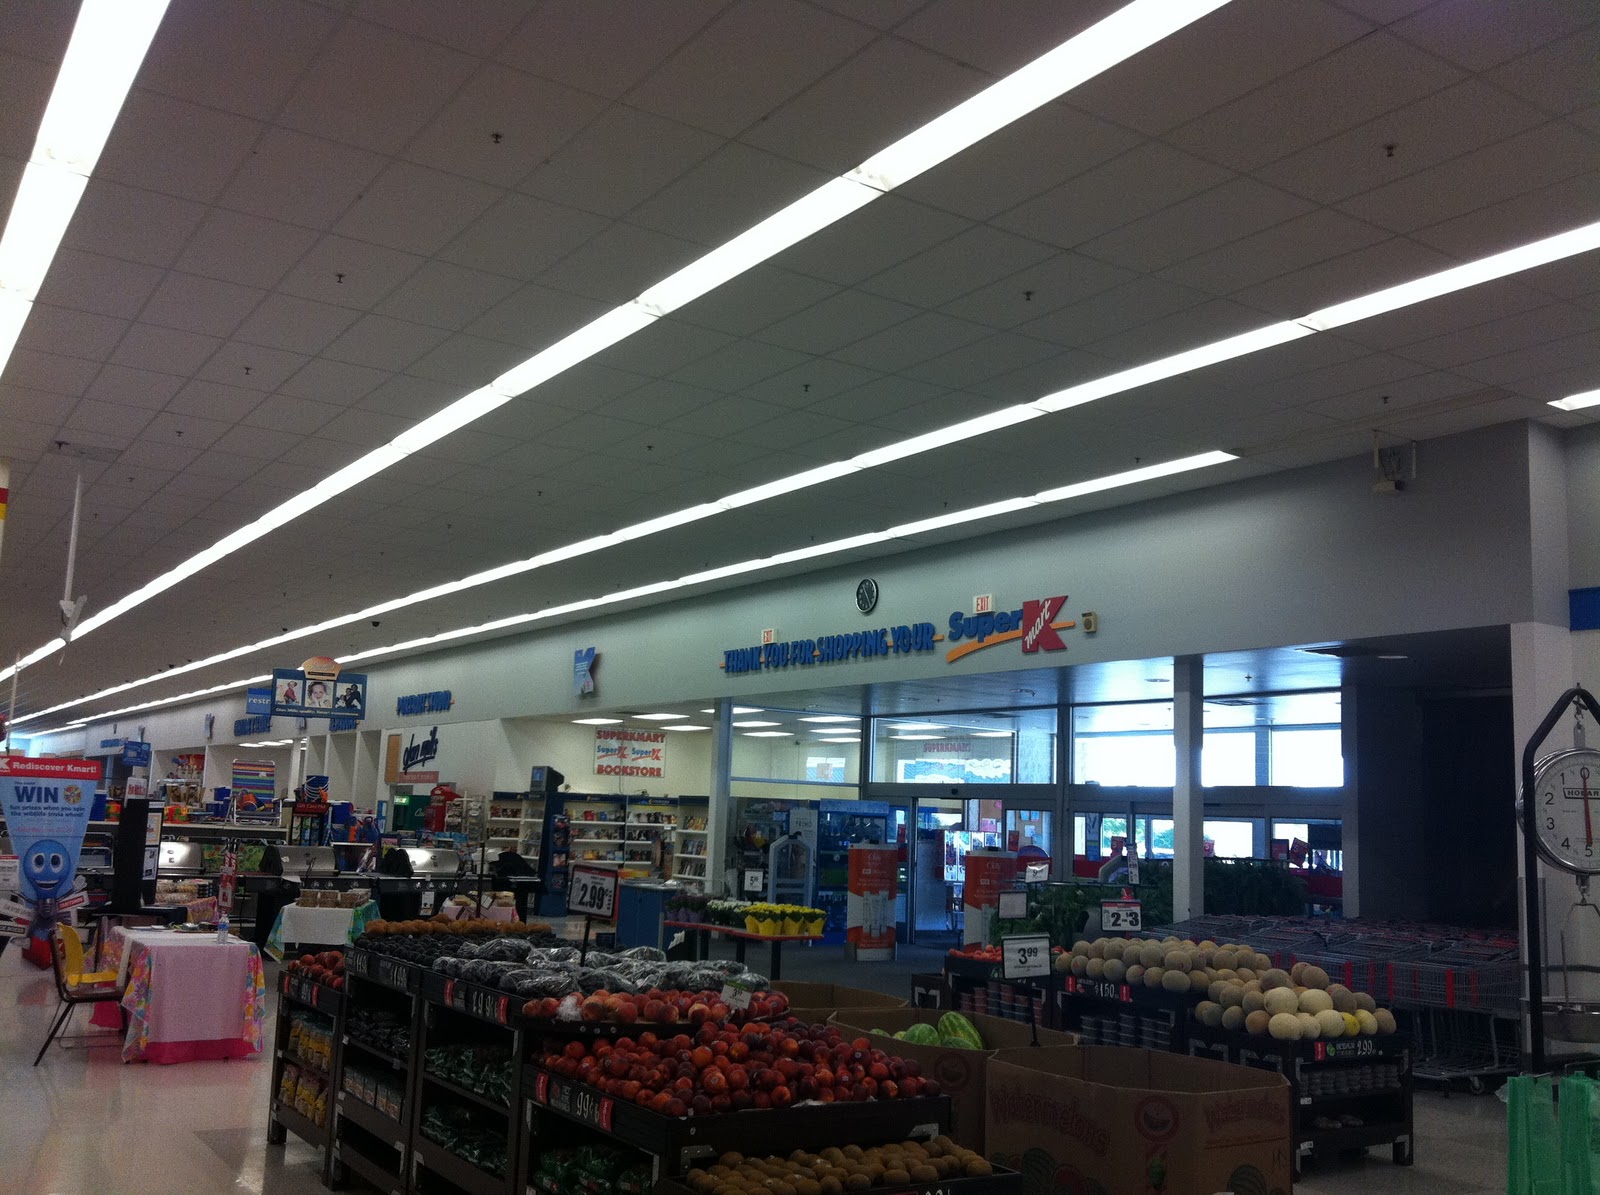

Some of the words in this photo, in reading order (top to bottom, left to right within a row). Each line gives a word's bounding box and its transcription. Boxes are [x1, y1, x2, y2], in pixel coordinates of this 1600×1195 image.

[976, 595, 990, 612] EXIT
[1024, 599, 1052, 650] mart
[724, 645, 762, 673] THANK
[764, 641, 790, 669] YOU
[790, 638, 816, 666] FOR
[816, 628, 888, 663] SHOPPING
[891, 621, 936, 653] YOUR
[948, 608, 1023, 644] Super
[596, 729, 666, 744] SUPERKMART
[597, 744, 618, 755] Super
[632, 747, 652, 757] Super
[12, 761, 65, 772] Rediscover
[67, 764, 97, 774] Kmart!
[597, 764, 662, 777] BOOKSTORE
[1560, 772, 1566, 785] 1
[14, 785, 59, 804] WIN
[1544, 792, 1554, 805] 2
[1546, 817, 1555, 830] 3
[1561, 837, 1571, 850] 4
[1585, 845, 1593, 858] 5
[1111, 912, 1121, 927] 2
